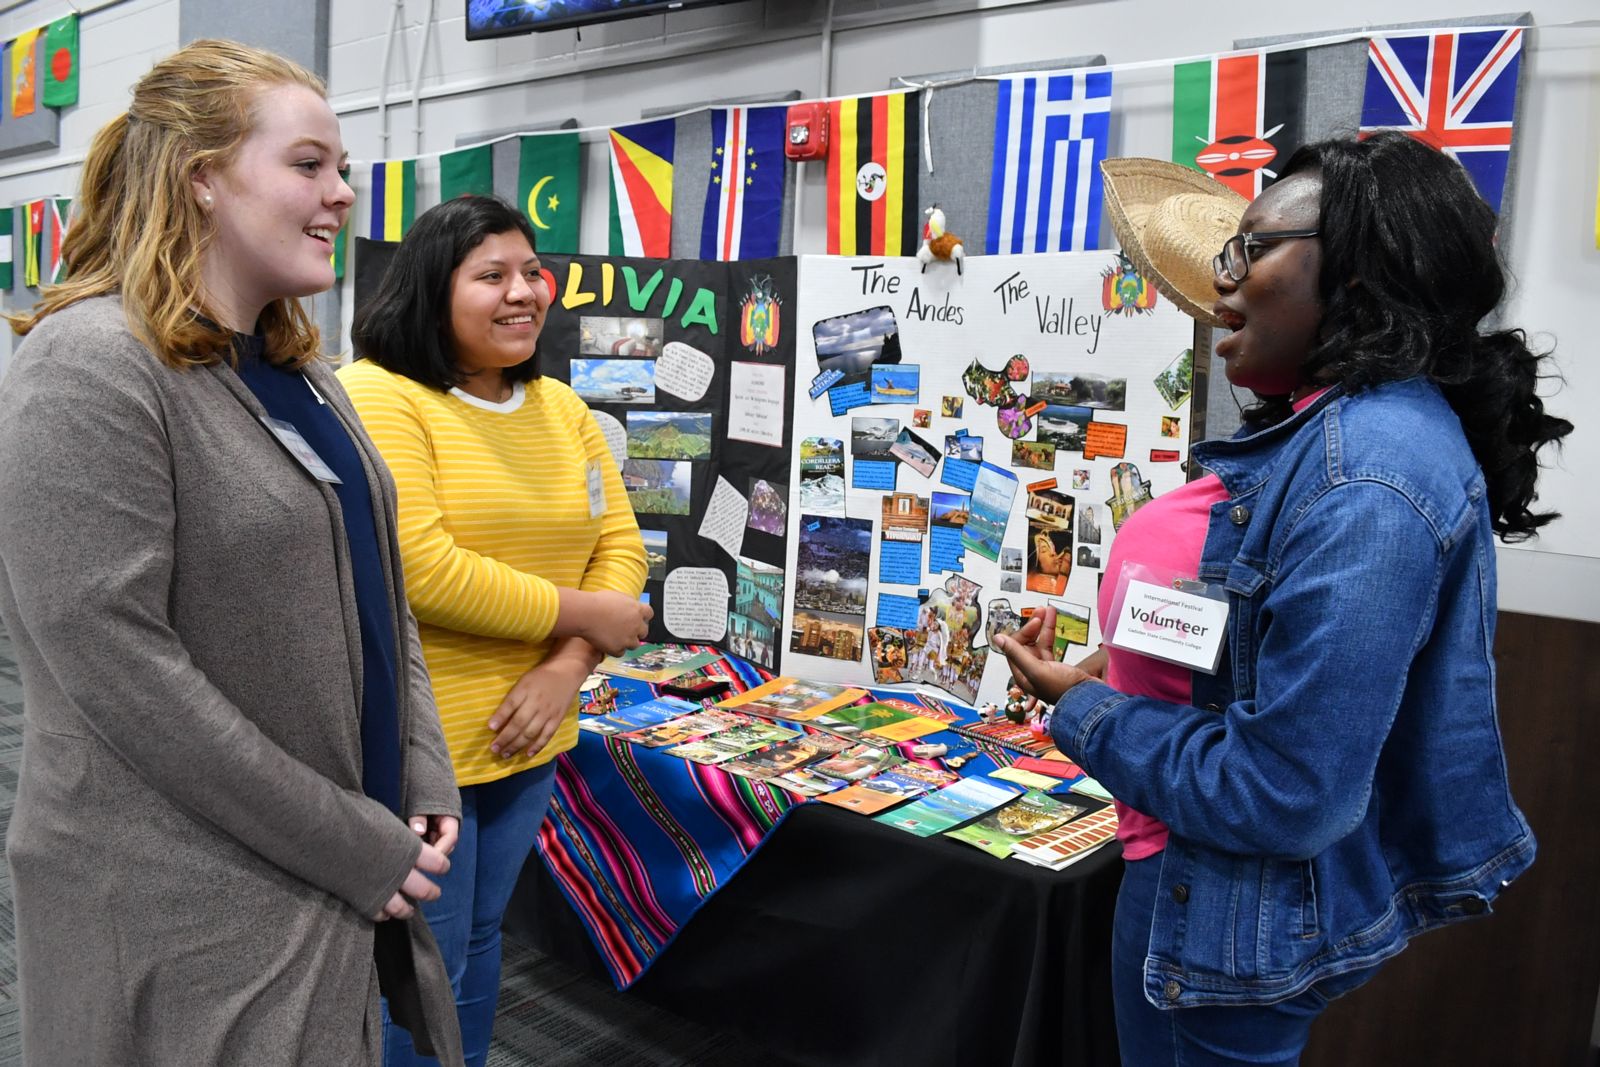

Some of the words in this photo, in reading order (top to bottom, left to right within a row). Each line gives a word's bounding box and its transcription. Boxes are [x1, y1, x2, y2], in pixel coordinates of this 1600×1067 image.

[851, 263, 901, 296] The
[993, 271, 1031, 314] The
[906, 287, 964, 325] Andes
[1035, 295, 1102, 355] Valley
[800, 457, 841, 465] CORDILLERA
[1144, 593, 1181, 606] International
[1181, 601, 1204, 612] Festival
[1131, 606, 1209, 637] Volunteer
[1159, 635, 1184, 646] Community
[1185, 642, 1202, 650] College
[884, 700, 940, 720] BOLIVIA
[679, 836, 699, 865] BOLIVIA
